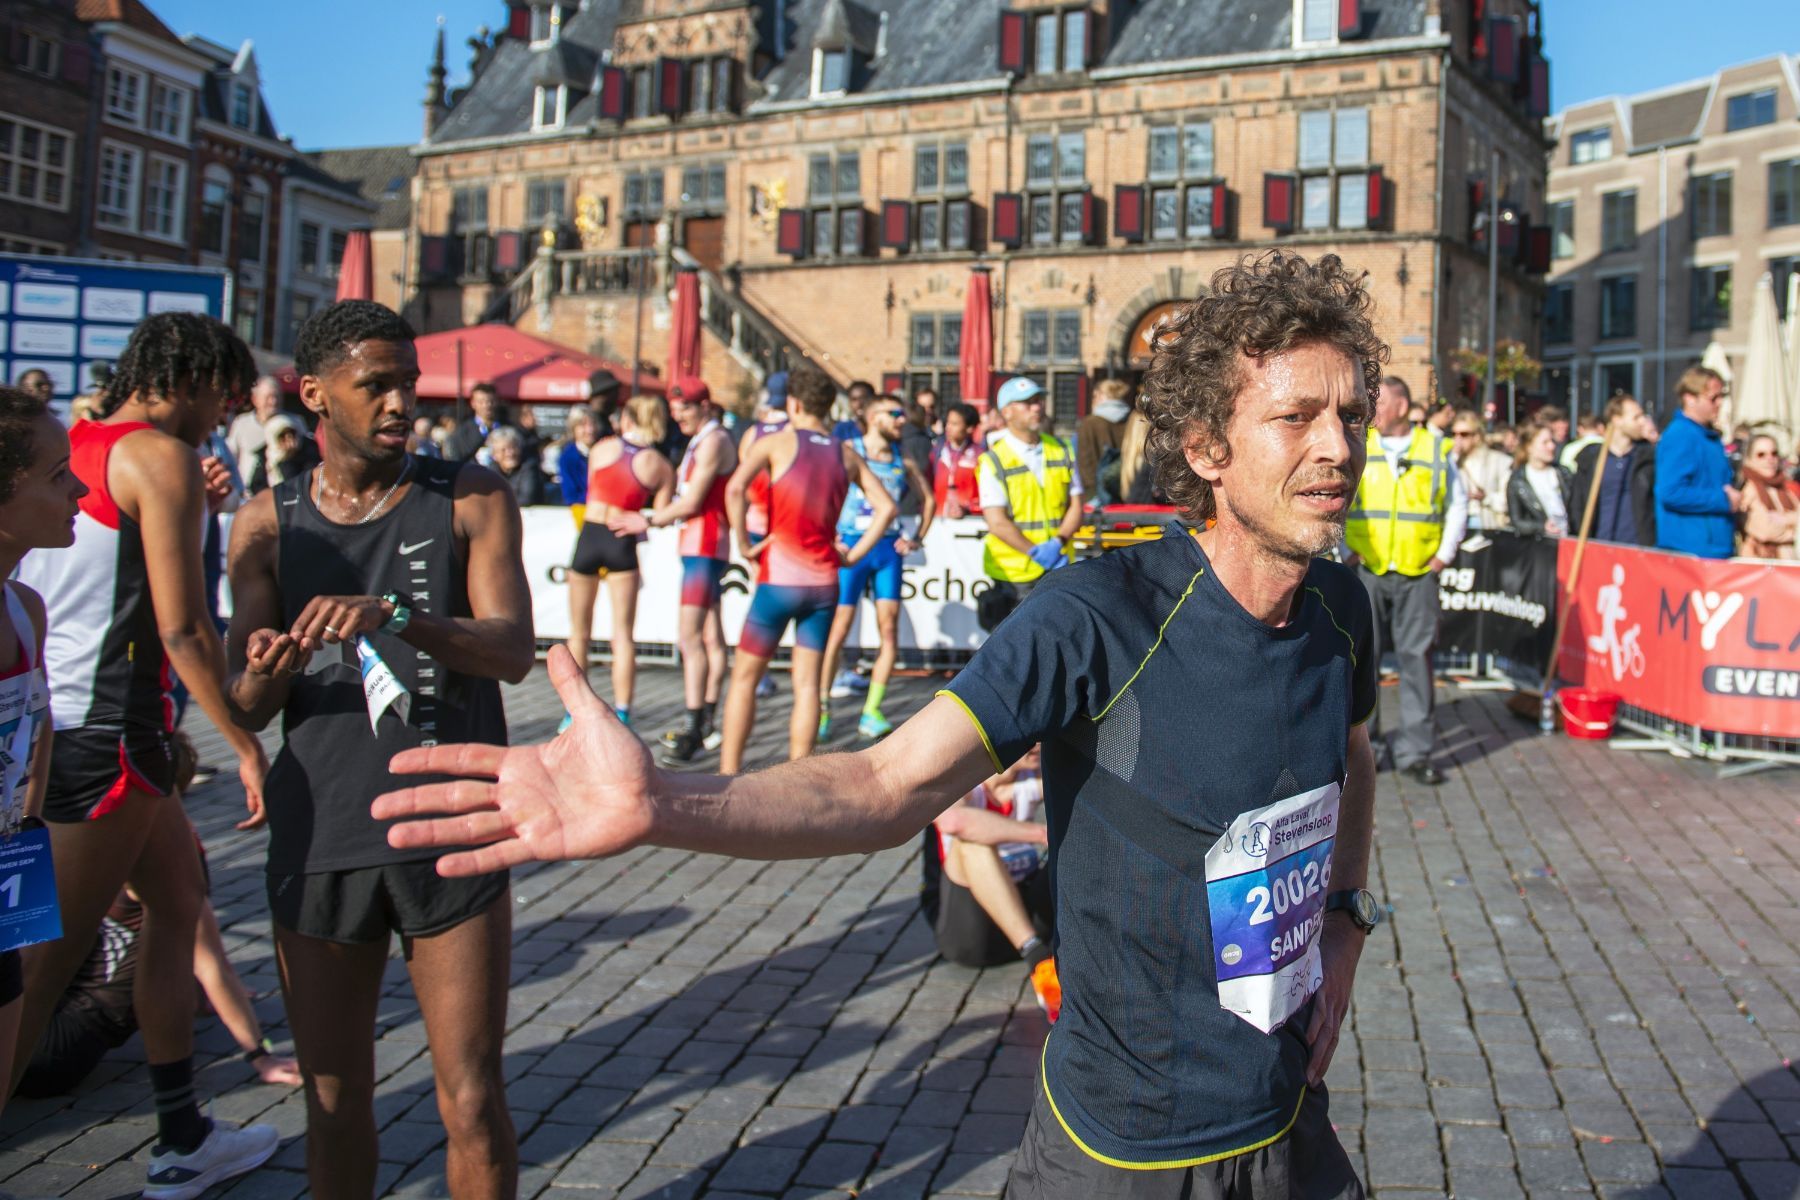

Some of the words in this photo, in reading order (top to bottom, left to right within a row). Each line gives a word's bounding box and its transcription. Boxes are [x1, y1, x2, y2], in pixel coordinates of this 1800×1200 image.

[410, 560, 430, 613] NIK
[1715, 667, 1799, 697] EVEN
[1274, 813, 1333, 846] Stevensloop
[1275, 815, 1290, 830] Alfa
[1291, 809, 1310, 825] Laval
[1246, 854, 1331, 925] 20026
